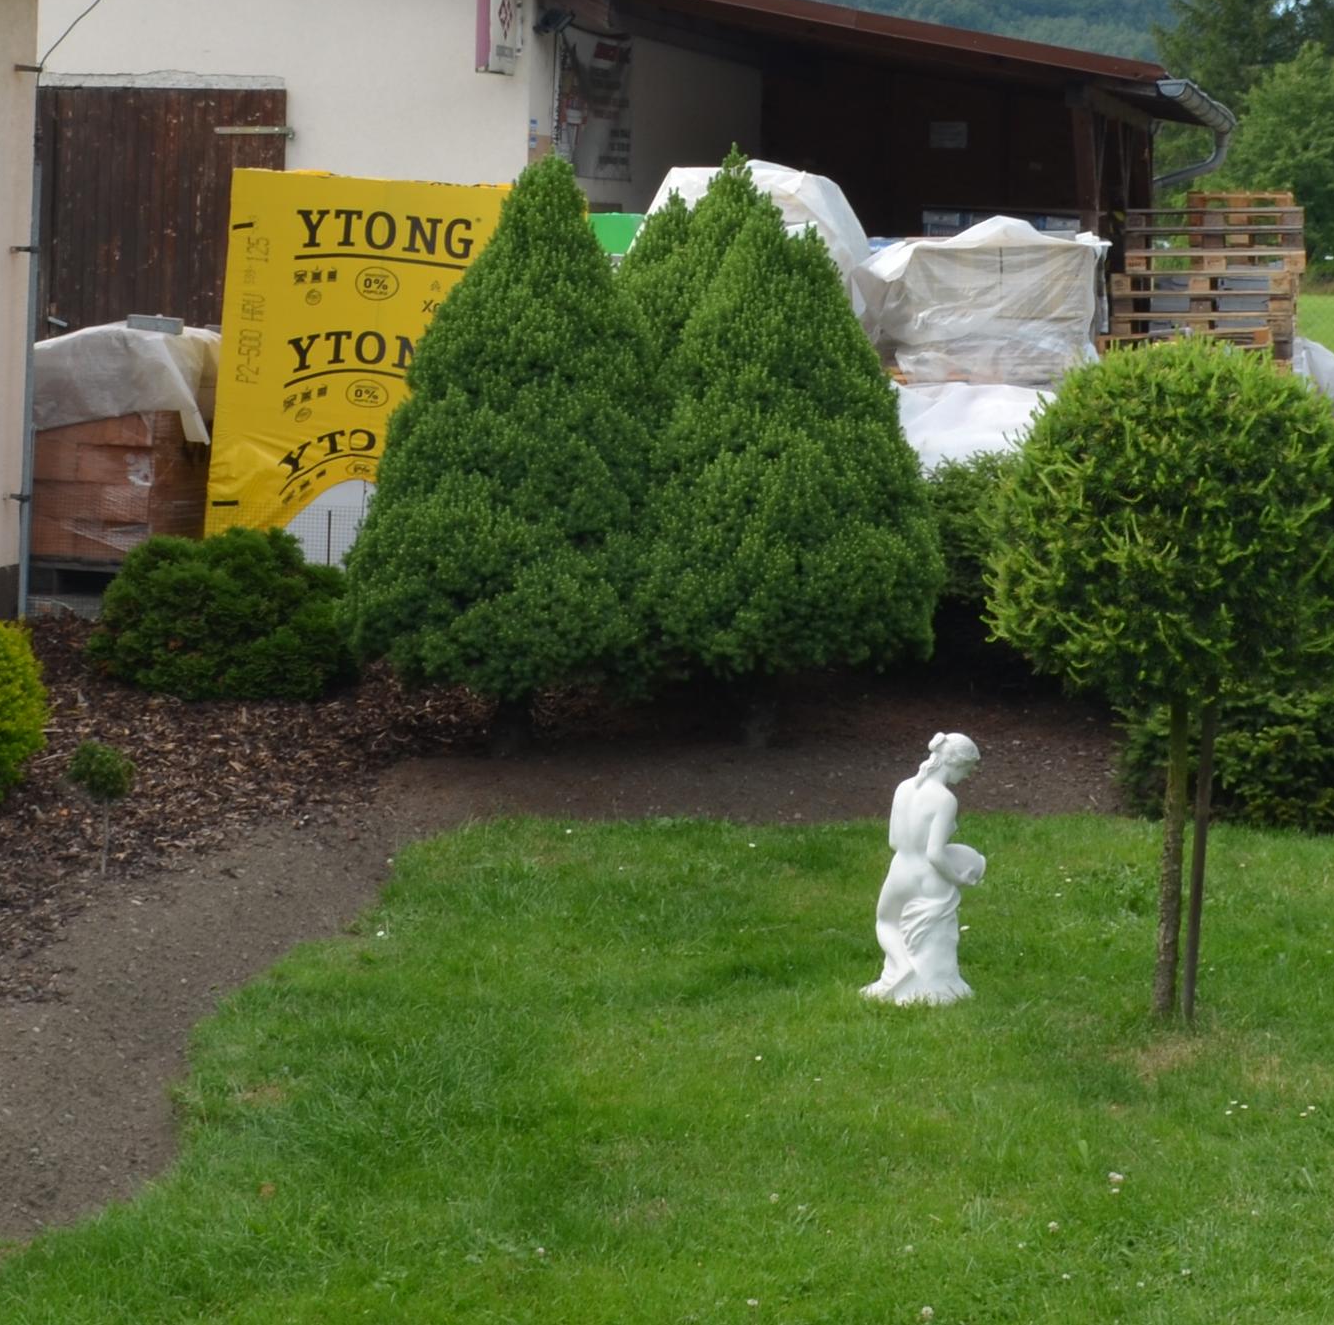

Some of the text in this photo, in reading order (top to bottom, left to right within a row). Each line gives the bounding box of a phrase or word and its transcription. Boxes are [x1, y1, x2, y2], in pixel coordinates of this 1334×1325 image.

[297, 209, 474, 260] YTONG
[288, 330, 418, 373] YTON
[278, 429, 377, 479] YTO
